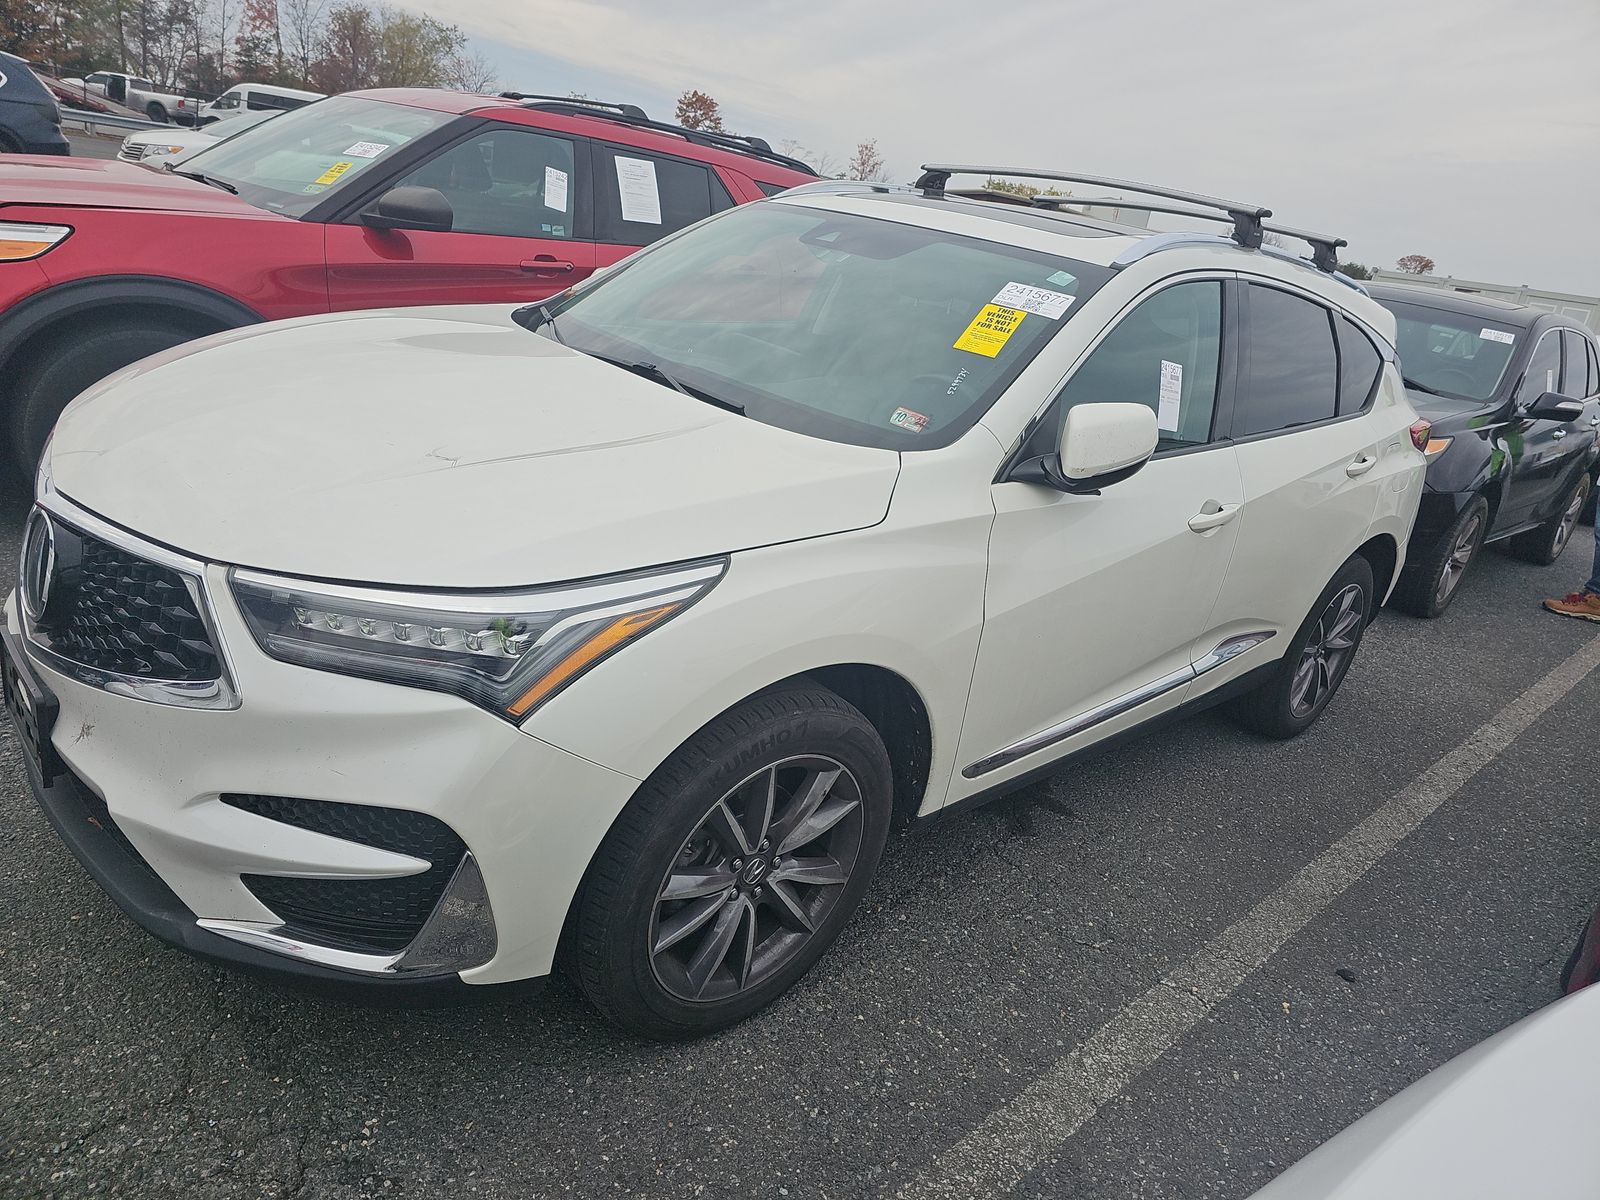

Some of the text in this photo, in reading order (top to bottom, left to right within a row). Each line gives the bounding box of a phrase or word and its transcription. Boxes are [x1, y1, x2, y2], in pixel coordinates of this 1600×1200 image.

[1006, 284, 1070, 305] 2415677
[986, 311, 1019, 323] VEHICLE
[997, 307, 1016, 316] THIS
[976, 321, 1013, 334] FOR SALE
[994, 318, 1013, 327] NOT
[894, 411, 908, 423] 10
